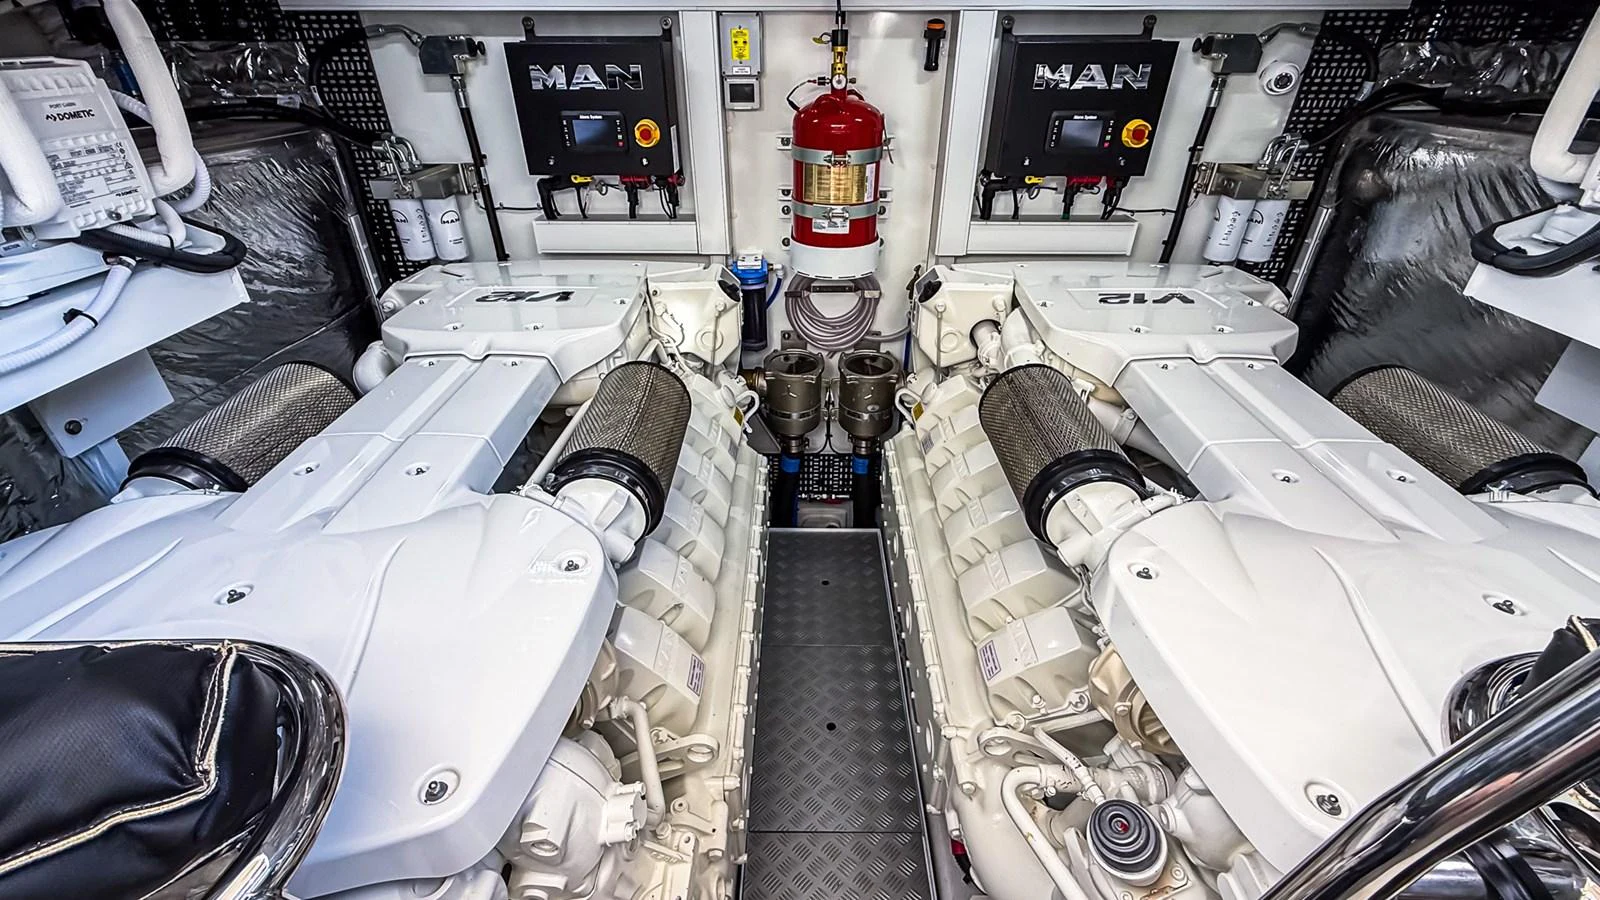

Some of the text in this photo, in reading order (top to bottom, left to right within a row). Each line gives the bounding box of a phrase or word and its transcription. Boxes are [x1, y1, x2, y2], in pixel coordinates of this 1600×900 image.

[529, 64, 644, 90] MAN
[1032, 63, 1153, 90] MAN
[56, 109, 95, 121] DOMETIC
[1098, 293, 1196, 304] V12
